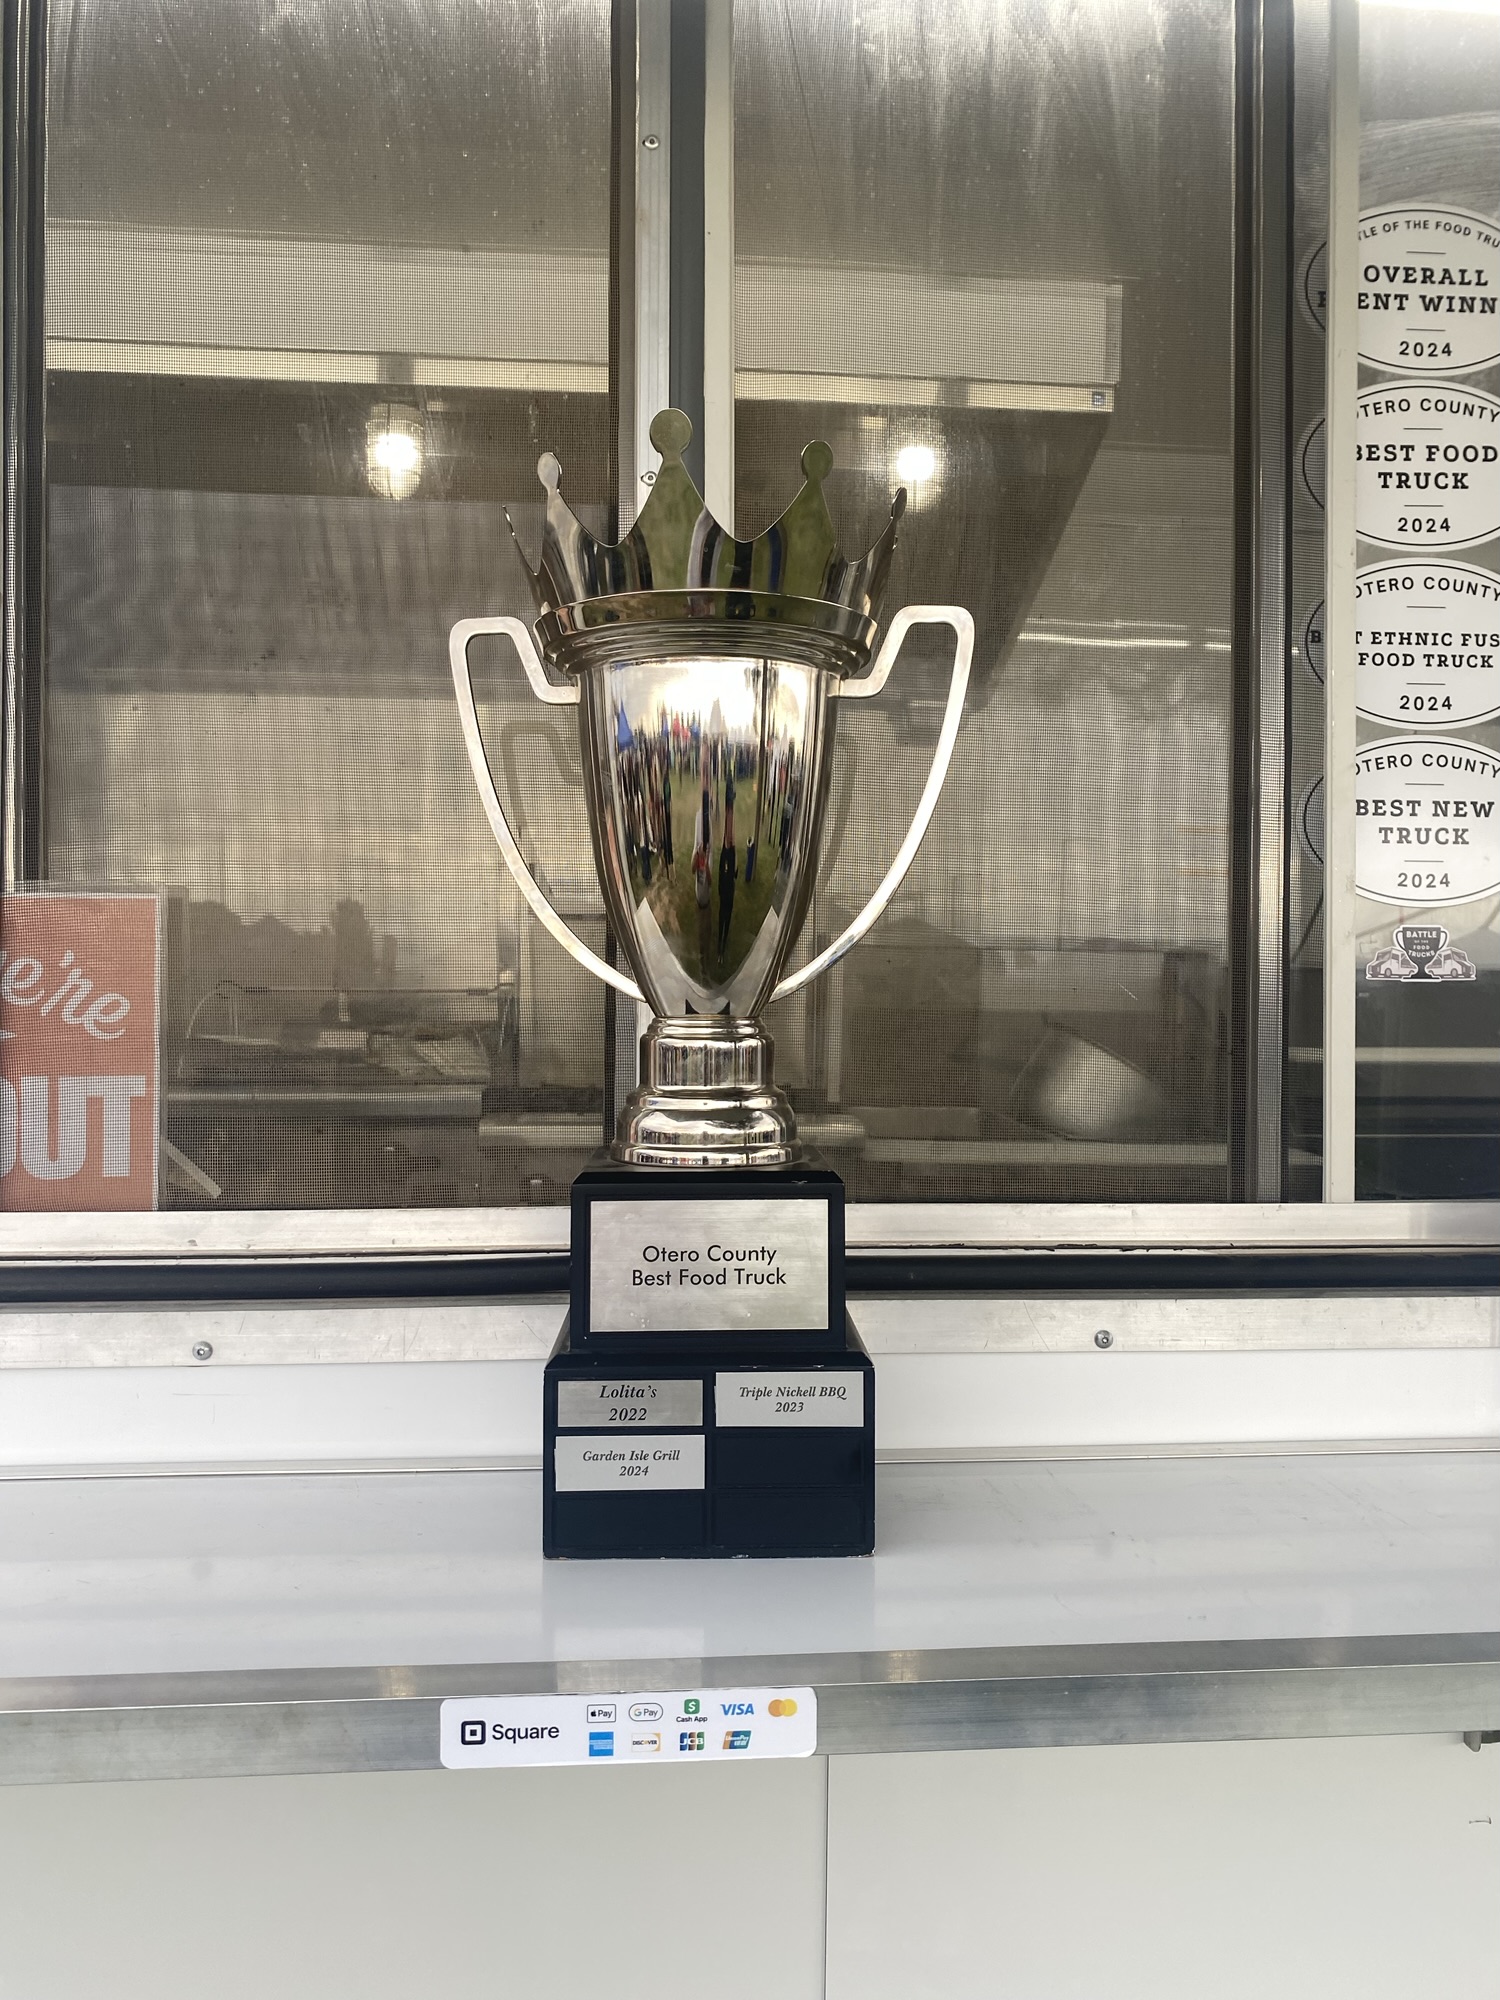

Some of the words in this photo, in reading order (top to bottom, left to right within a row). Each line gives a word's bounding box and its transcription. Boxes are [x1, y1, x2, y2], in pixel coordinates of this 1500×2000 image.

[1382, 221, 1400, 233] OF
[1404, 219, 1430, 230] THE
[1435, 220, 1471, 236] FOOD
[1476, 230, 1500, 249] TRU
[1363, 264, 1489, 287] OVERALL
[1419, 294, 1500, 314] WINN
[1399, 340, 1452, 358] 2024
[1357, 398, 1411, 419] TERO
[1420, 398, 1500, 424] COUNTY
[1426, 444, 1498, 463] FOOD
[1377, 471, 1469, 490] TRUCK
[1397, 517, 1451, 533] 2024
[1423, 576, 1500, 602] COUNTY
[1370, 631, 1453, 647] ETHNIC
[1461, 633, 1500, 648] FUS
[1358, 652, 1415, 667] FOOD
[1423, 653, 1494, 669] TRUCK
[1399, 695, 1453, 711] 2024
[1422, 753, 1500, 779] COUNTY
[1356, 799, 1422, 817] BEST
[1432, 800, 1495, 818] NEW
[1378, 826, 1470, 845] TRUCK
[1397, 872, 1451, 889] 2024
[1406, 930, 1437, 938] BATTLE
[1408, 949, 1435, 958] TRUCKS
[0, 949, 130, 1040] e're
[0, 1075, 146, 1180] UT
[643, 1245, 700, 1262] Otero
[707, 1245, 777, 1266] County
[632, 1269, 671, 1286] Best
[679, 1267, 727, 1285] Food
[734, 1267, 787, 1285] Truck
[599, 1384, 657, 1398] Lolita’s
[739, 1386, 773, 1400] Triple
[776, 1386, 816, 1397] Nickell
[819, 1386, 847, 1400] BBQ
[608, 1407, 647, 1421] 2022
[775, 1401, 804, 1412] 2023
[583, 1450, 625, 1461] Garden
[629, 1450, 649, 1460] Isle
[653, 1449, 680, 1461] Grill
[619, 1465, 649, 1476] 2024
[598, 1709, 613, 1718] Pay
[643, 1708, 658, 1718] Pay
[720, 1703, 754, 1716] VISA
[492, 1723, 560, 1744] Square
